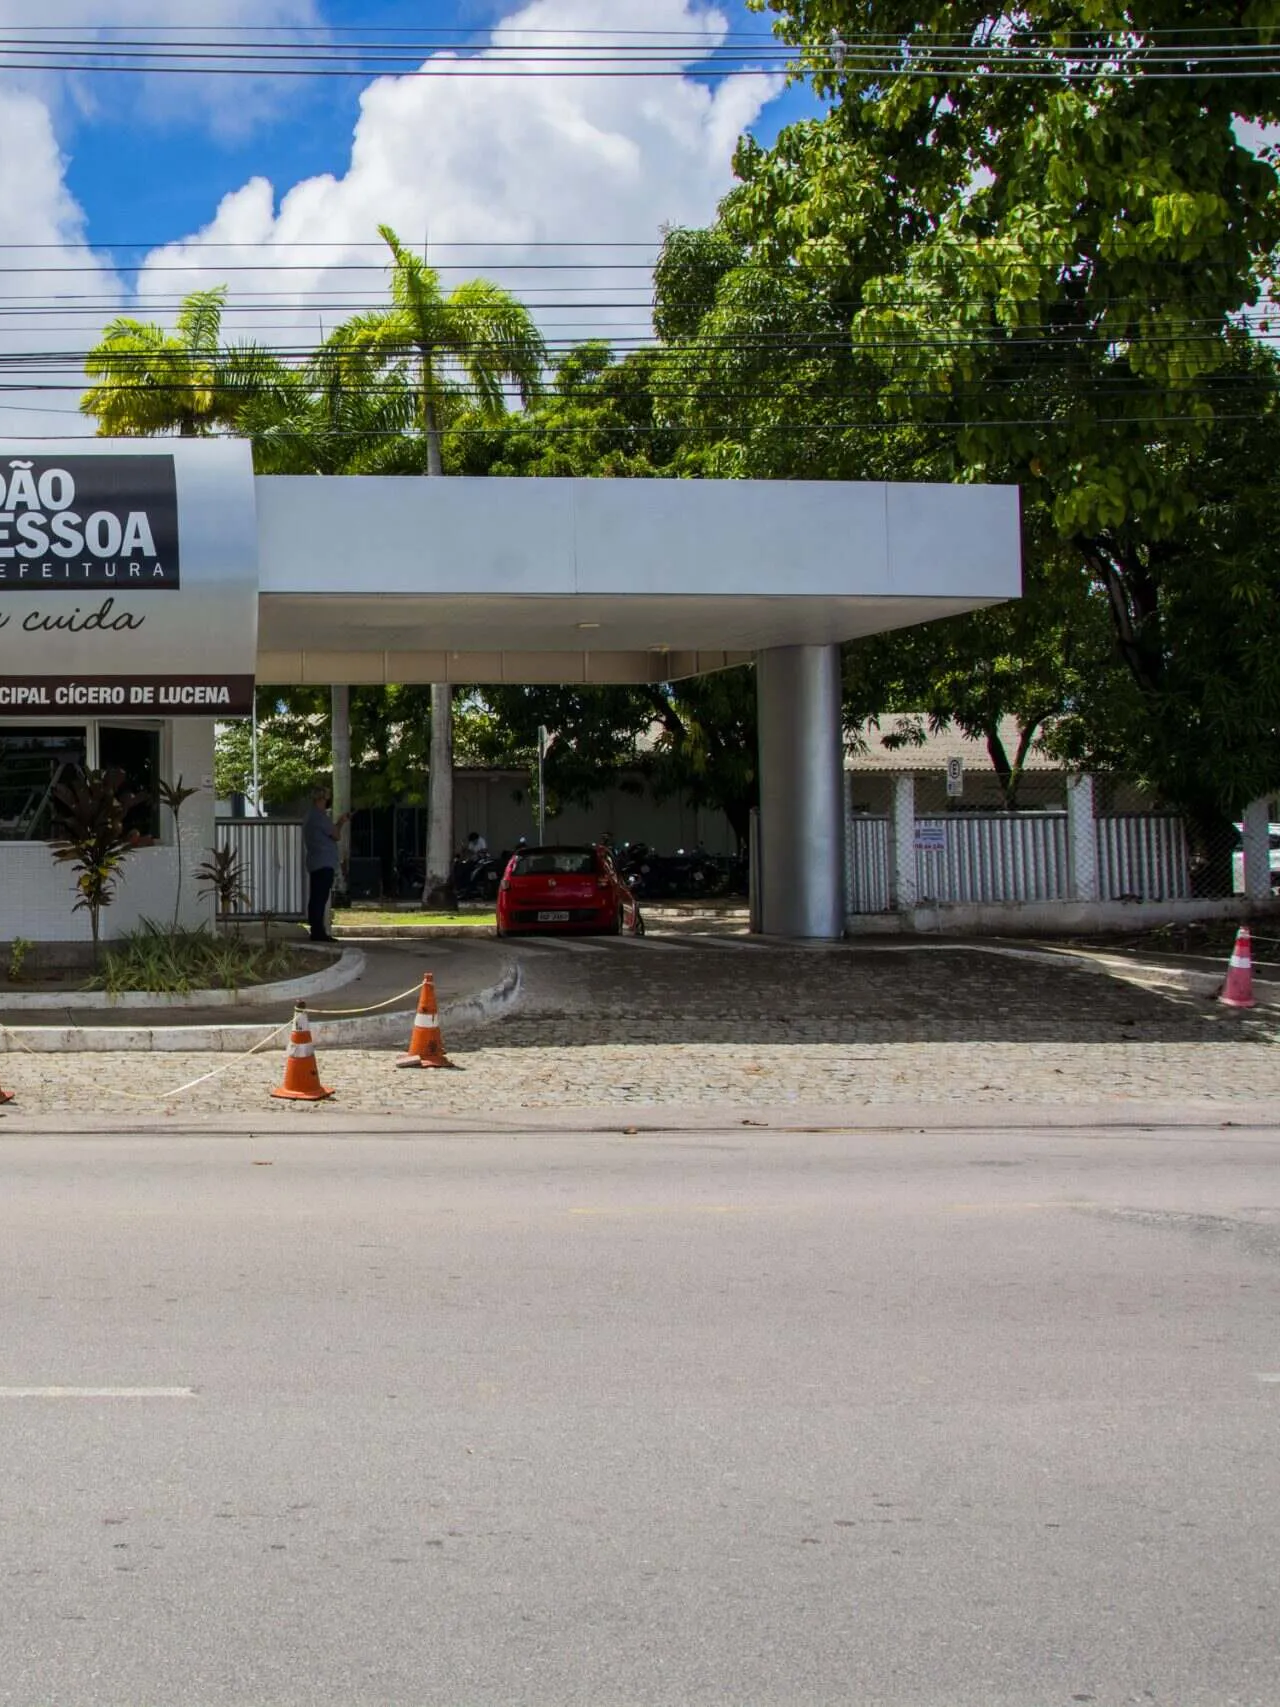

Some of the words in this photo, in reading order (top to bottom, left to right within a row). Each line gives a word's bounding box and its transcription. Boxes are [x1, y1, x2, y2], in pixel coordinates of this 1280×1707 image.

[22, 597, 145, 632] cuida
[55, 683, 125, 704] CÍCERO
[130, 687, 154, 704] DE
[159, 686, 230, 704] LUCENA
